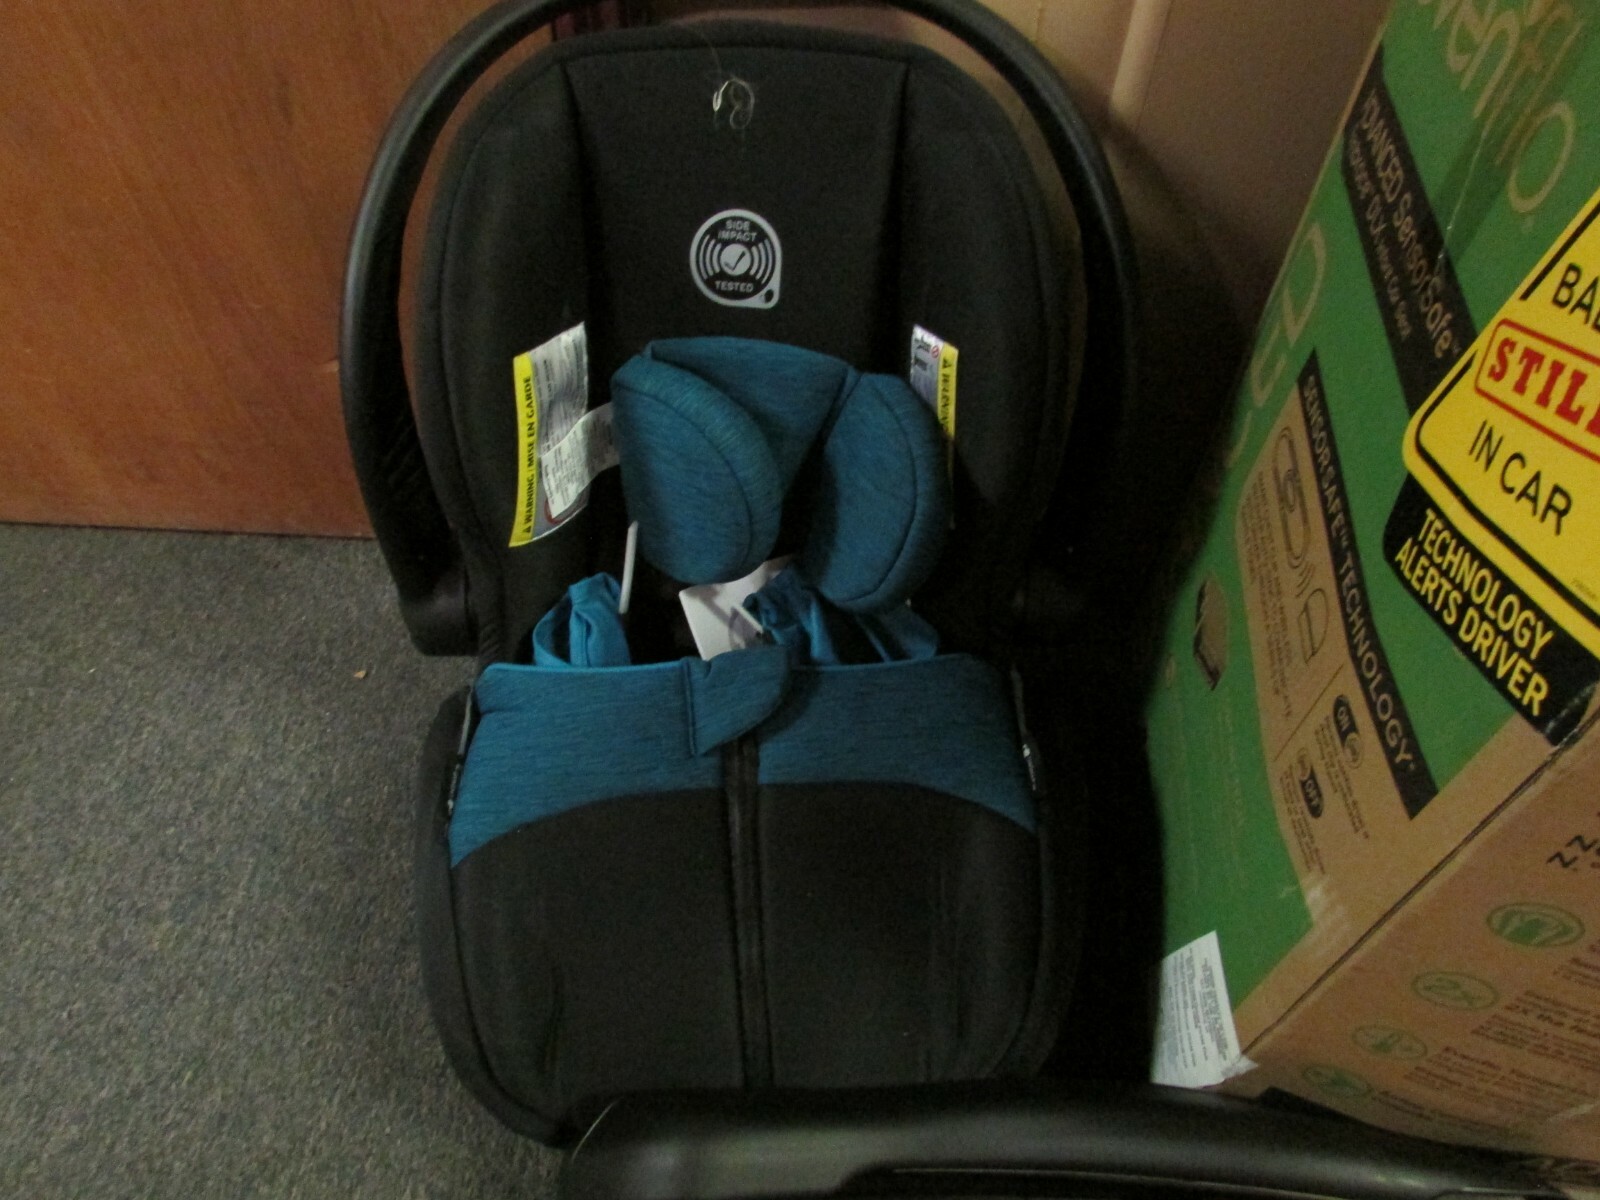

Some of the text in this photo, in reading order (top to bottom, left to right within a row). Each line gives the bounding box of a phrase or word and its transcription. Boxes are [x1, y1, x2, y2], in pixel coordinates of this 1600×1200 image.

[718, 230, 757, 242] IMPACT
[725, 219, 751, 231] SIDE
[715, 280, 754, 293] TESTED
[523, 376, 536, 522] WARNING MISE EN GARDE
[1468, 419, 1573, 537] IN CAR
[1394, 536, 1550, 718] ALERTS DRIVER
[1418, 507, 1554, 661] TECHNOLOGY
